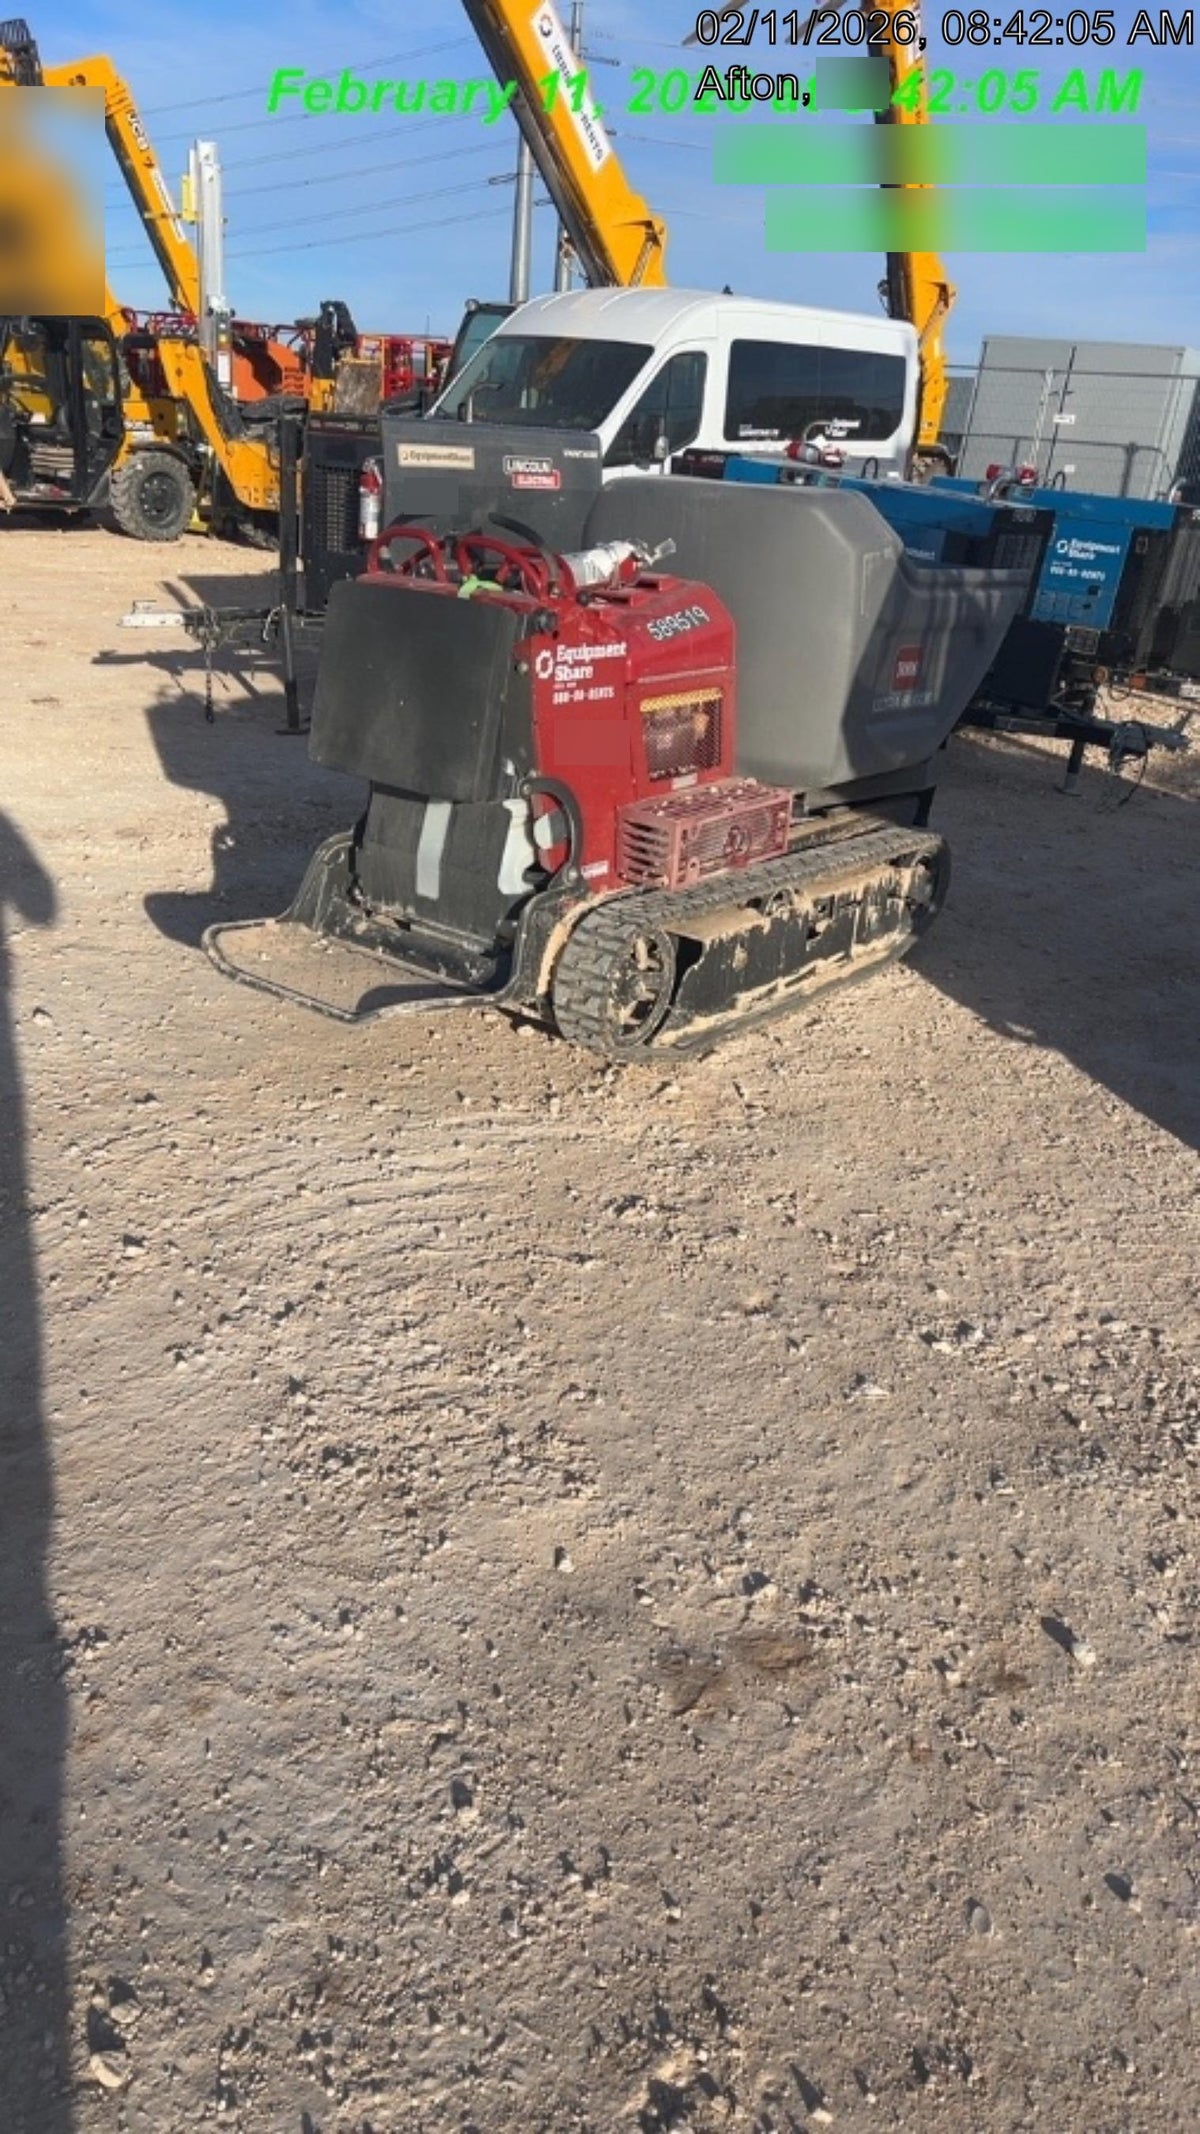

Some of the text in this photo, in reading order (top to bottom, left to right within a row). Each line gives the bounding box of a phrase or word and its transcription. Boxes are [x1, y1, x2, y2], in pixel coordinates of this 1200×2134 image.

[647, 605, 710, 641] 589519
[557, 641, 628, 665] Equipment
[554, 664, 594, 682] Share
